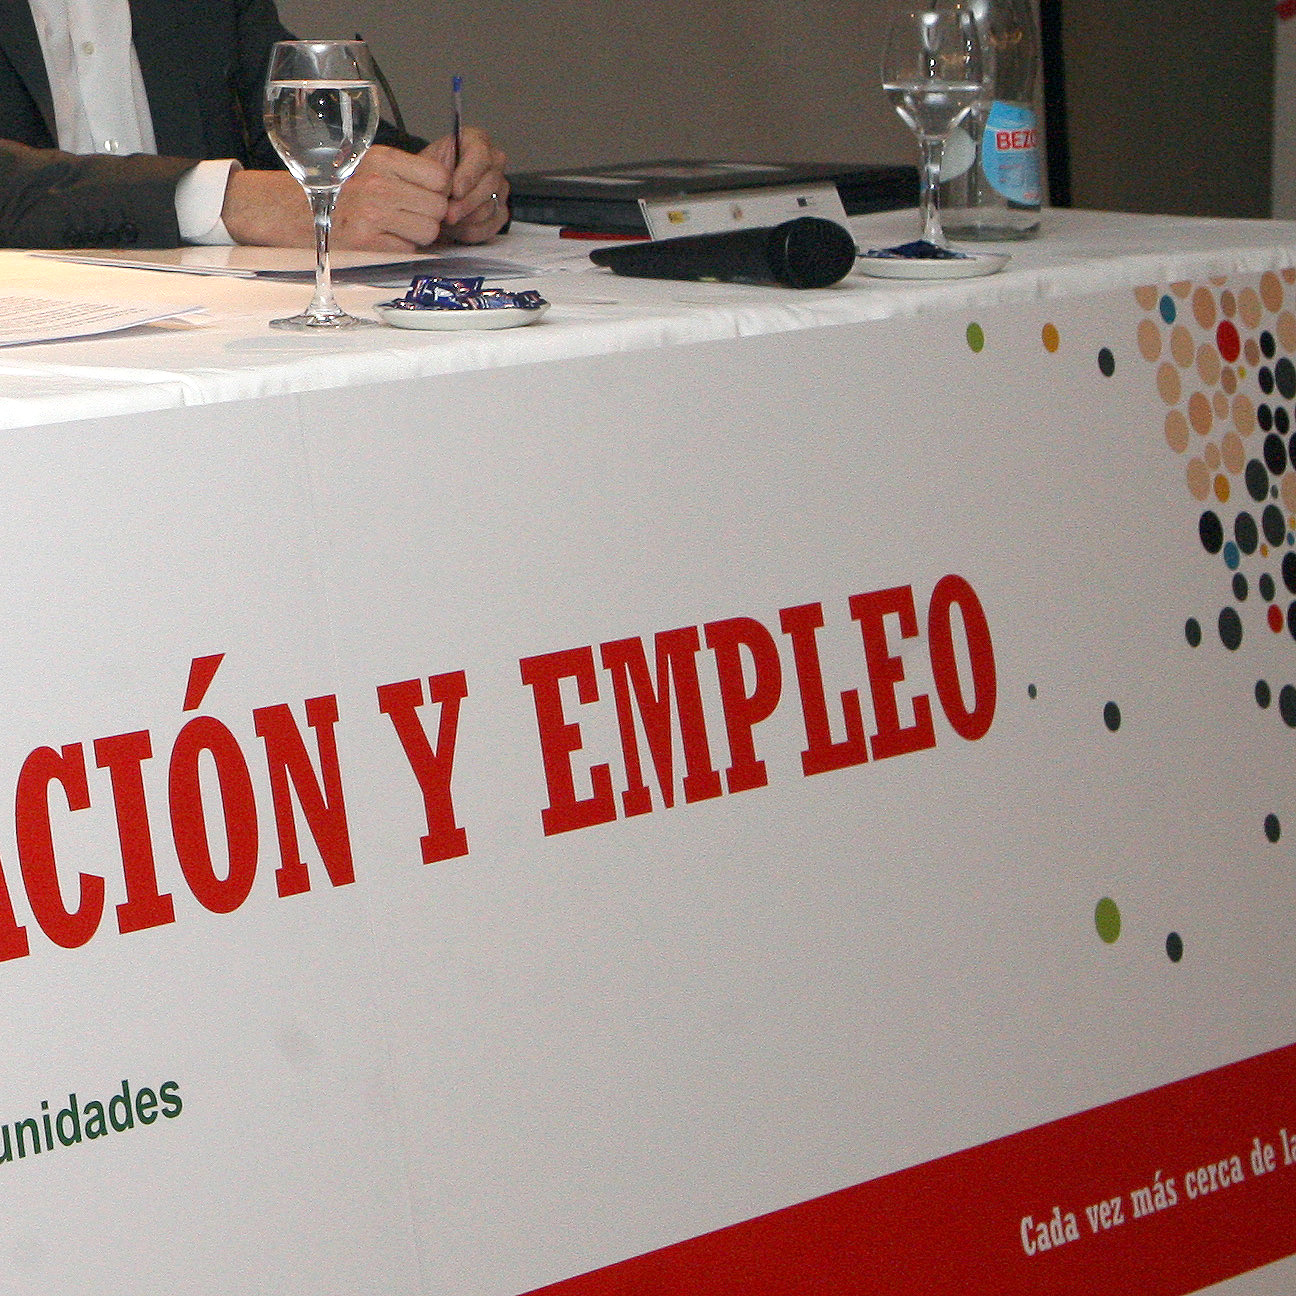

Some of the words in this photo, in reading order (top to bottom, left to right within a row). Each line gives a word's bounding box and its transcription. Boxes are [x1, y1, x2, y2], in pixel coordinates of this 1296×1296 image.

[376, 670, 470, 865] Y
[519, 574, 997, 837] EMPLEO
[1020, 1206, 1081, 1257] Cada
[1085, 1196, 1125, 1234] vez
[1130, 1170, 1179, 1219] más
[1184, 1155, 1245, 1200] cerca
[1250, 1137, 1277, 1176] de
